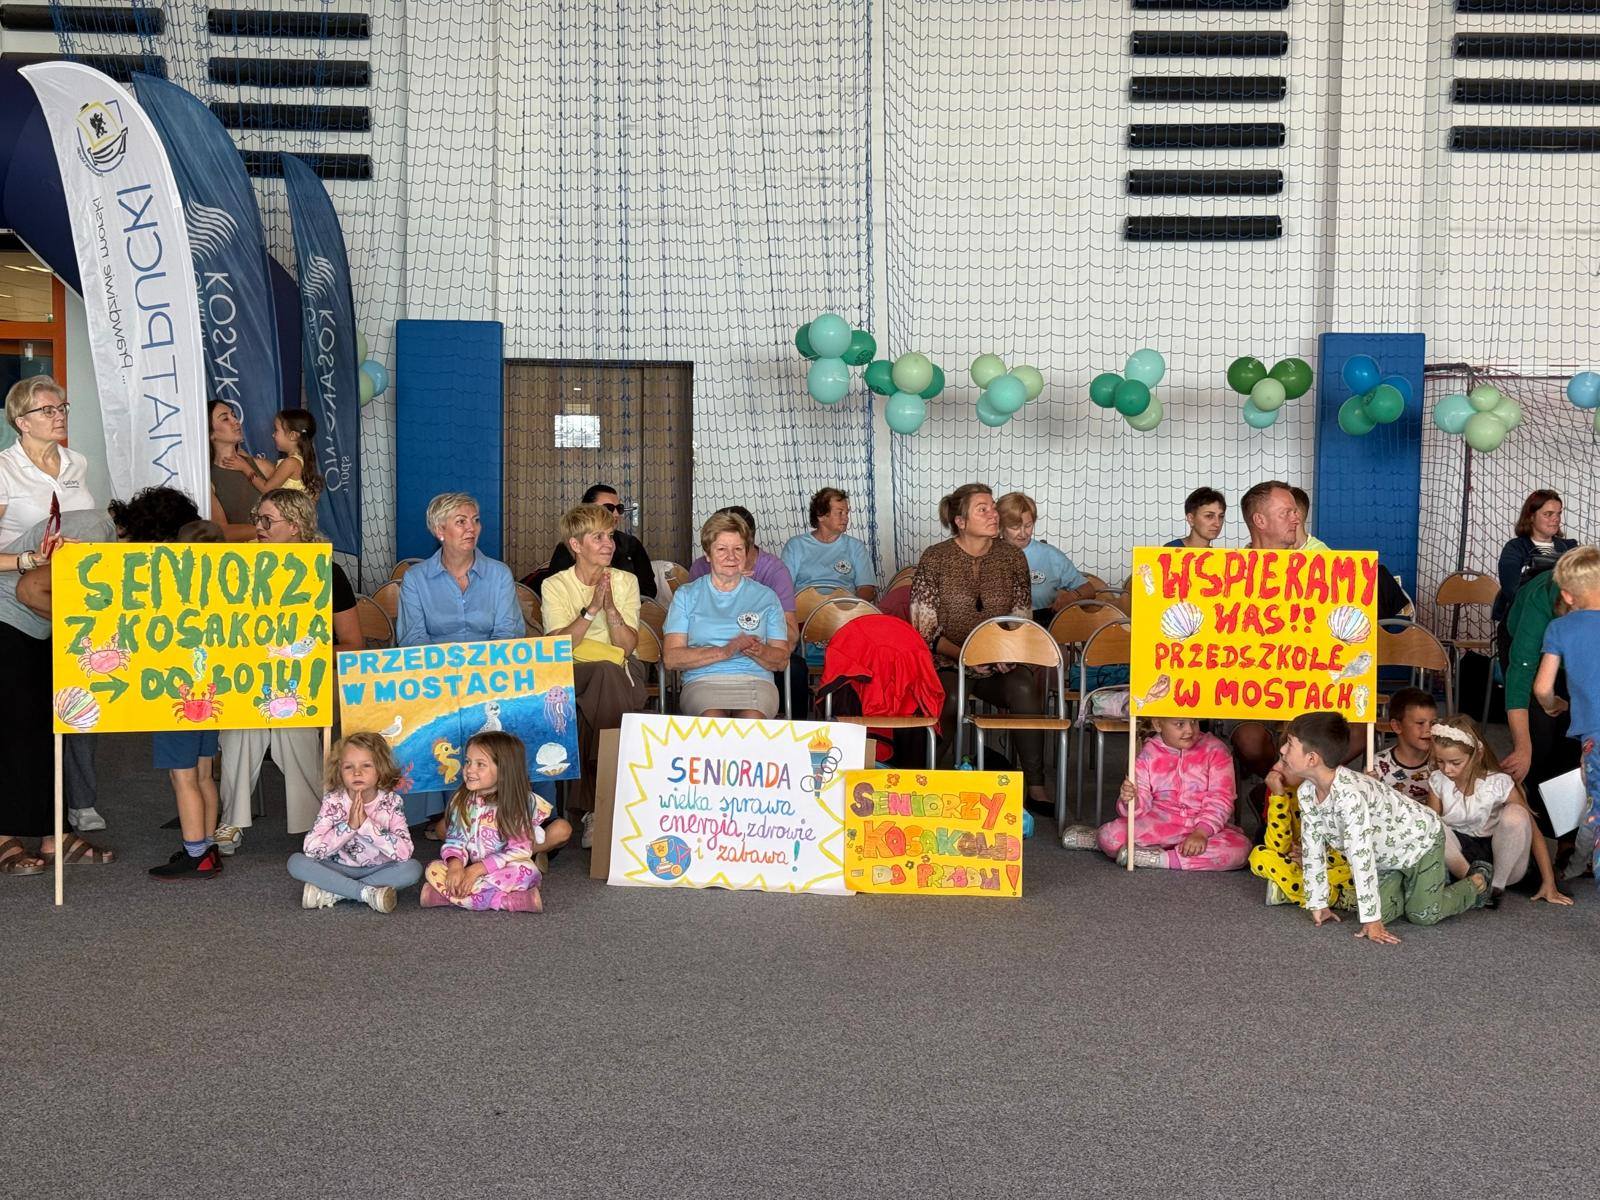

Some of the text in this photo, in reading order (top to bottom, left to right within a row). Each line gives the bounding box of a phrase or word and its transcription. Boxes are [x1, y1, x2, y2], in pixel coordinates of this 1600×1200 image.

[76, 545, 332, 611] SENIORZY
[1157, 551, 1378, 606] WSPIERAMY
[64, 608, 331, 655] Z KOSAKOWA
[1213, 602, 1316, 637] WAS!!
[339, 640, 573, 675] PRZEDSZKOLE
[1155, 643, 1344, 671] PRZEDSZKOLE
[141, 666, 194, 700] DO
[342, 669, 535, 705] W MOSTACH
[1173, 677, 1354, 709] W MOSTACH
[667, 756, 791, 790] SENIORADA
[659, 786, 796, 820] wielka sprawa
[695, 838, 704, 860] i
[872, 864, 906, 885] DO
